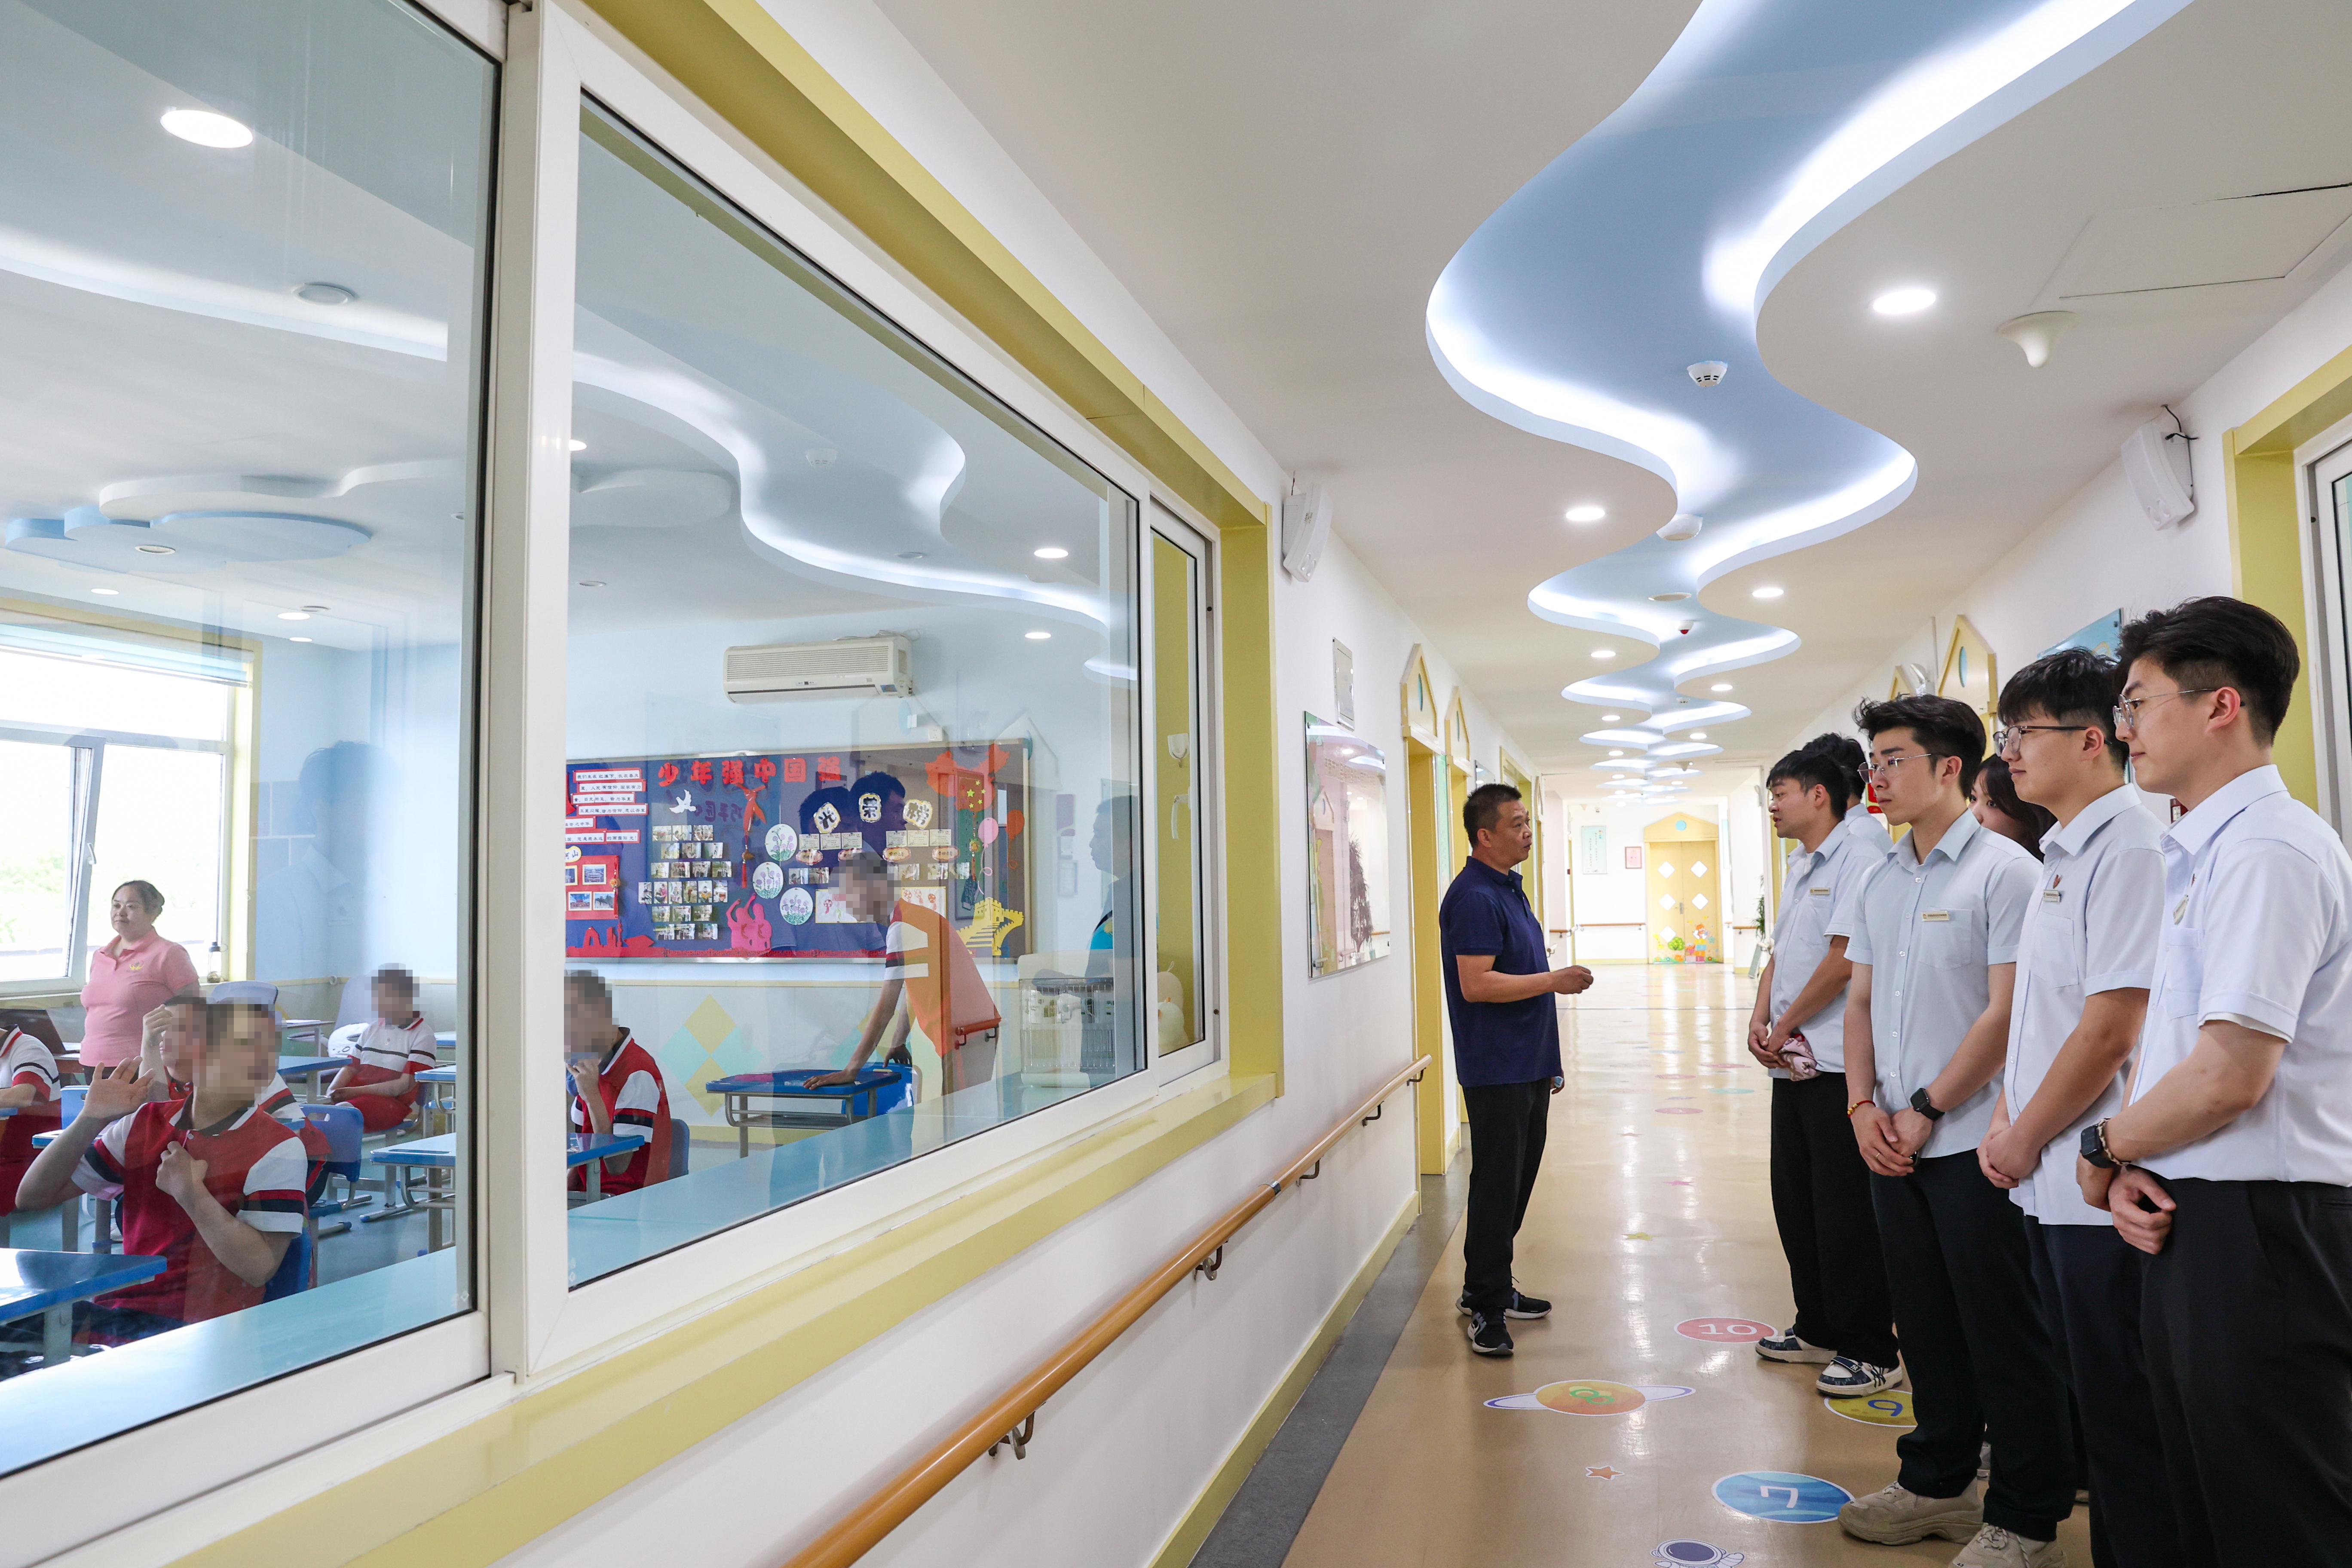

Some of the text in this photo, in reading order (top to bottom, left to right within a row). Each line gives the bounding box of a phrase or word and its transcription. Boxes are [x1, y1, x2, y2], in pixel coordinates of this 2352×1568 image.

[658, 756, 841, 787] 少年强中国强
[1698, 1323, 1758, 1335] 10
[1570, 1389, 1615, 1405] 8
[1868, 1399, 1903, 1417] 9
[1760, 1485, 1799, 1508] 7
